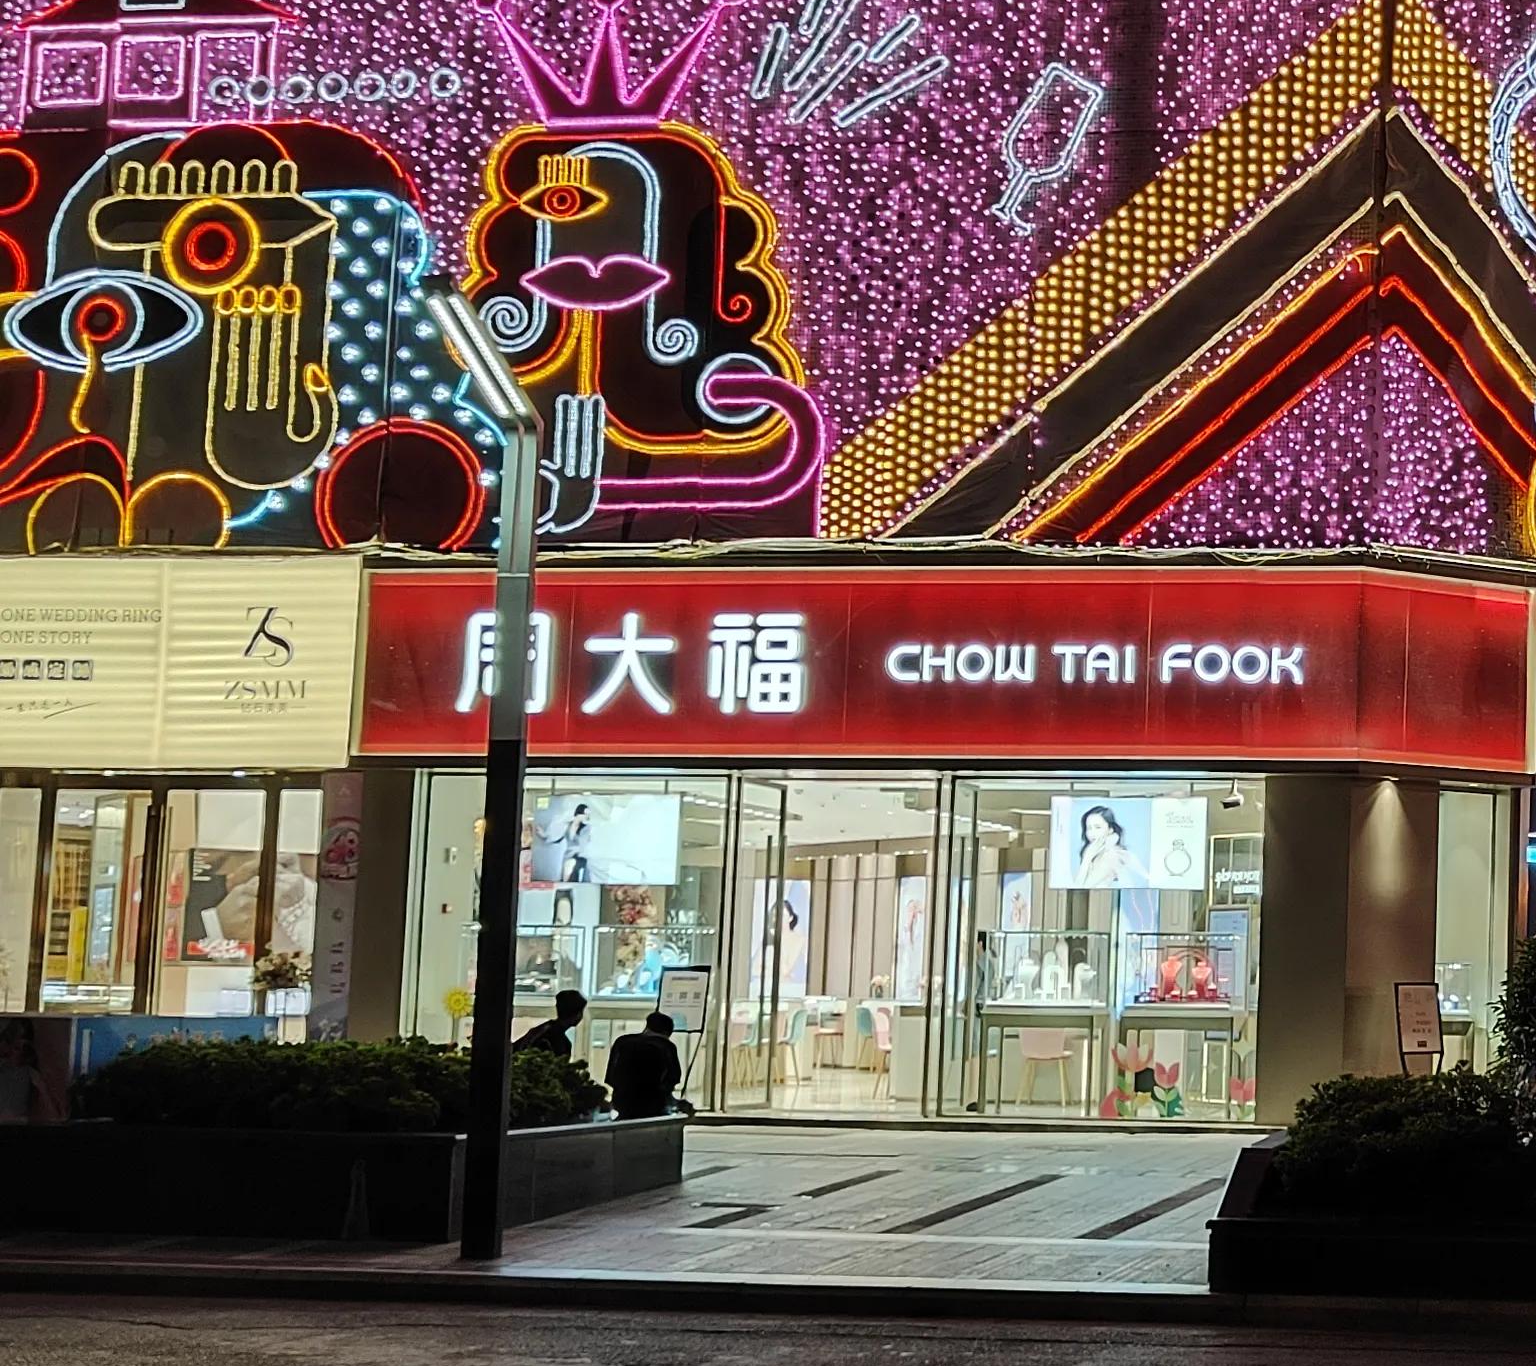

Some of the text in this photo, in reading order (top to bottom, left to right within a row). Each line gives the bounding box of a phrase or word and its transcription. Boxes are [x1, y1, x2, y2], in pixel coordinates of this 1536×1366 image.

[1, 608, 162, 624] ONE WEDDING RING
[1, 630, 93, 645] ONE STORY
[455, 611, 806, 715] 周大福
[886, 644, 1306, 685] CHOW TAI FOOK
[223, 679, 306, 700] ZSMM
